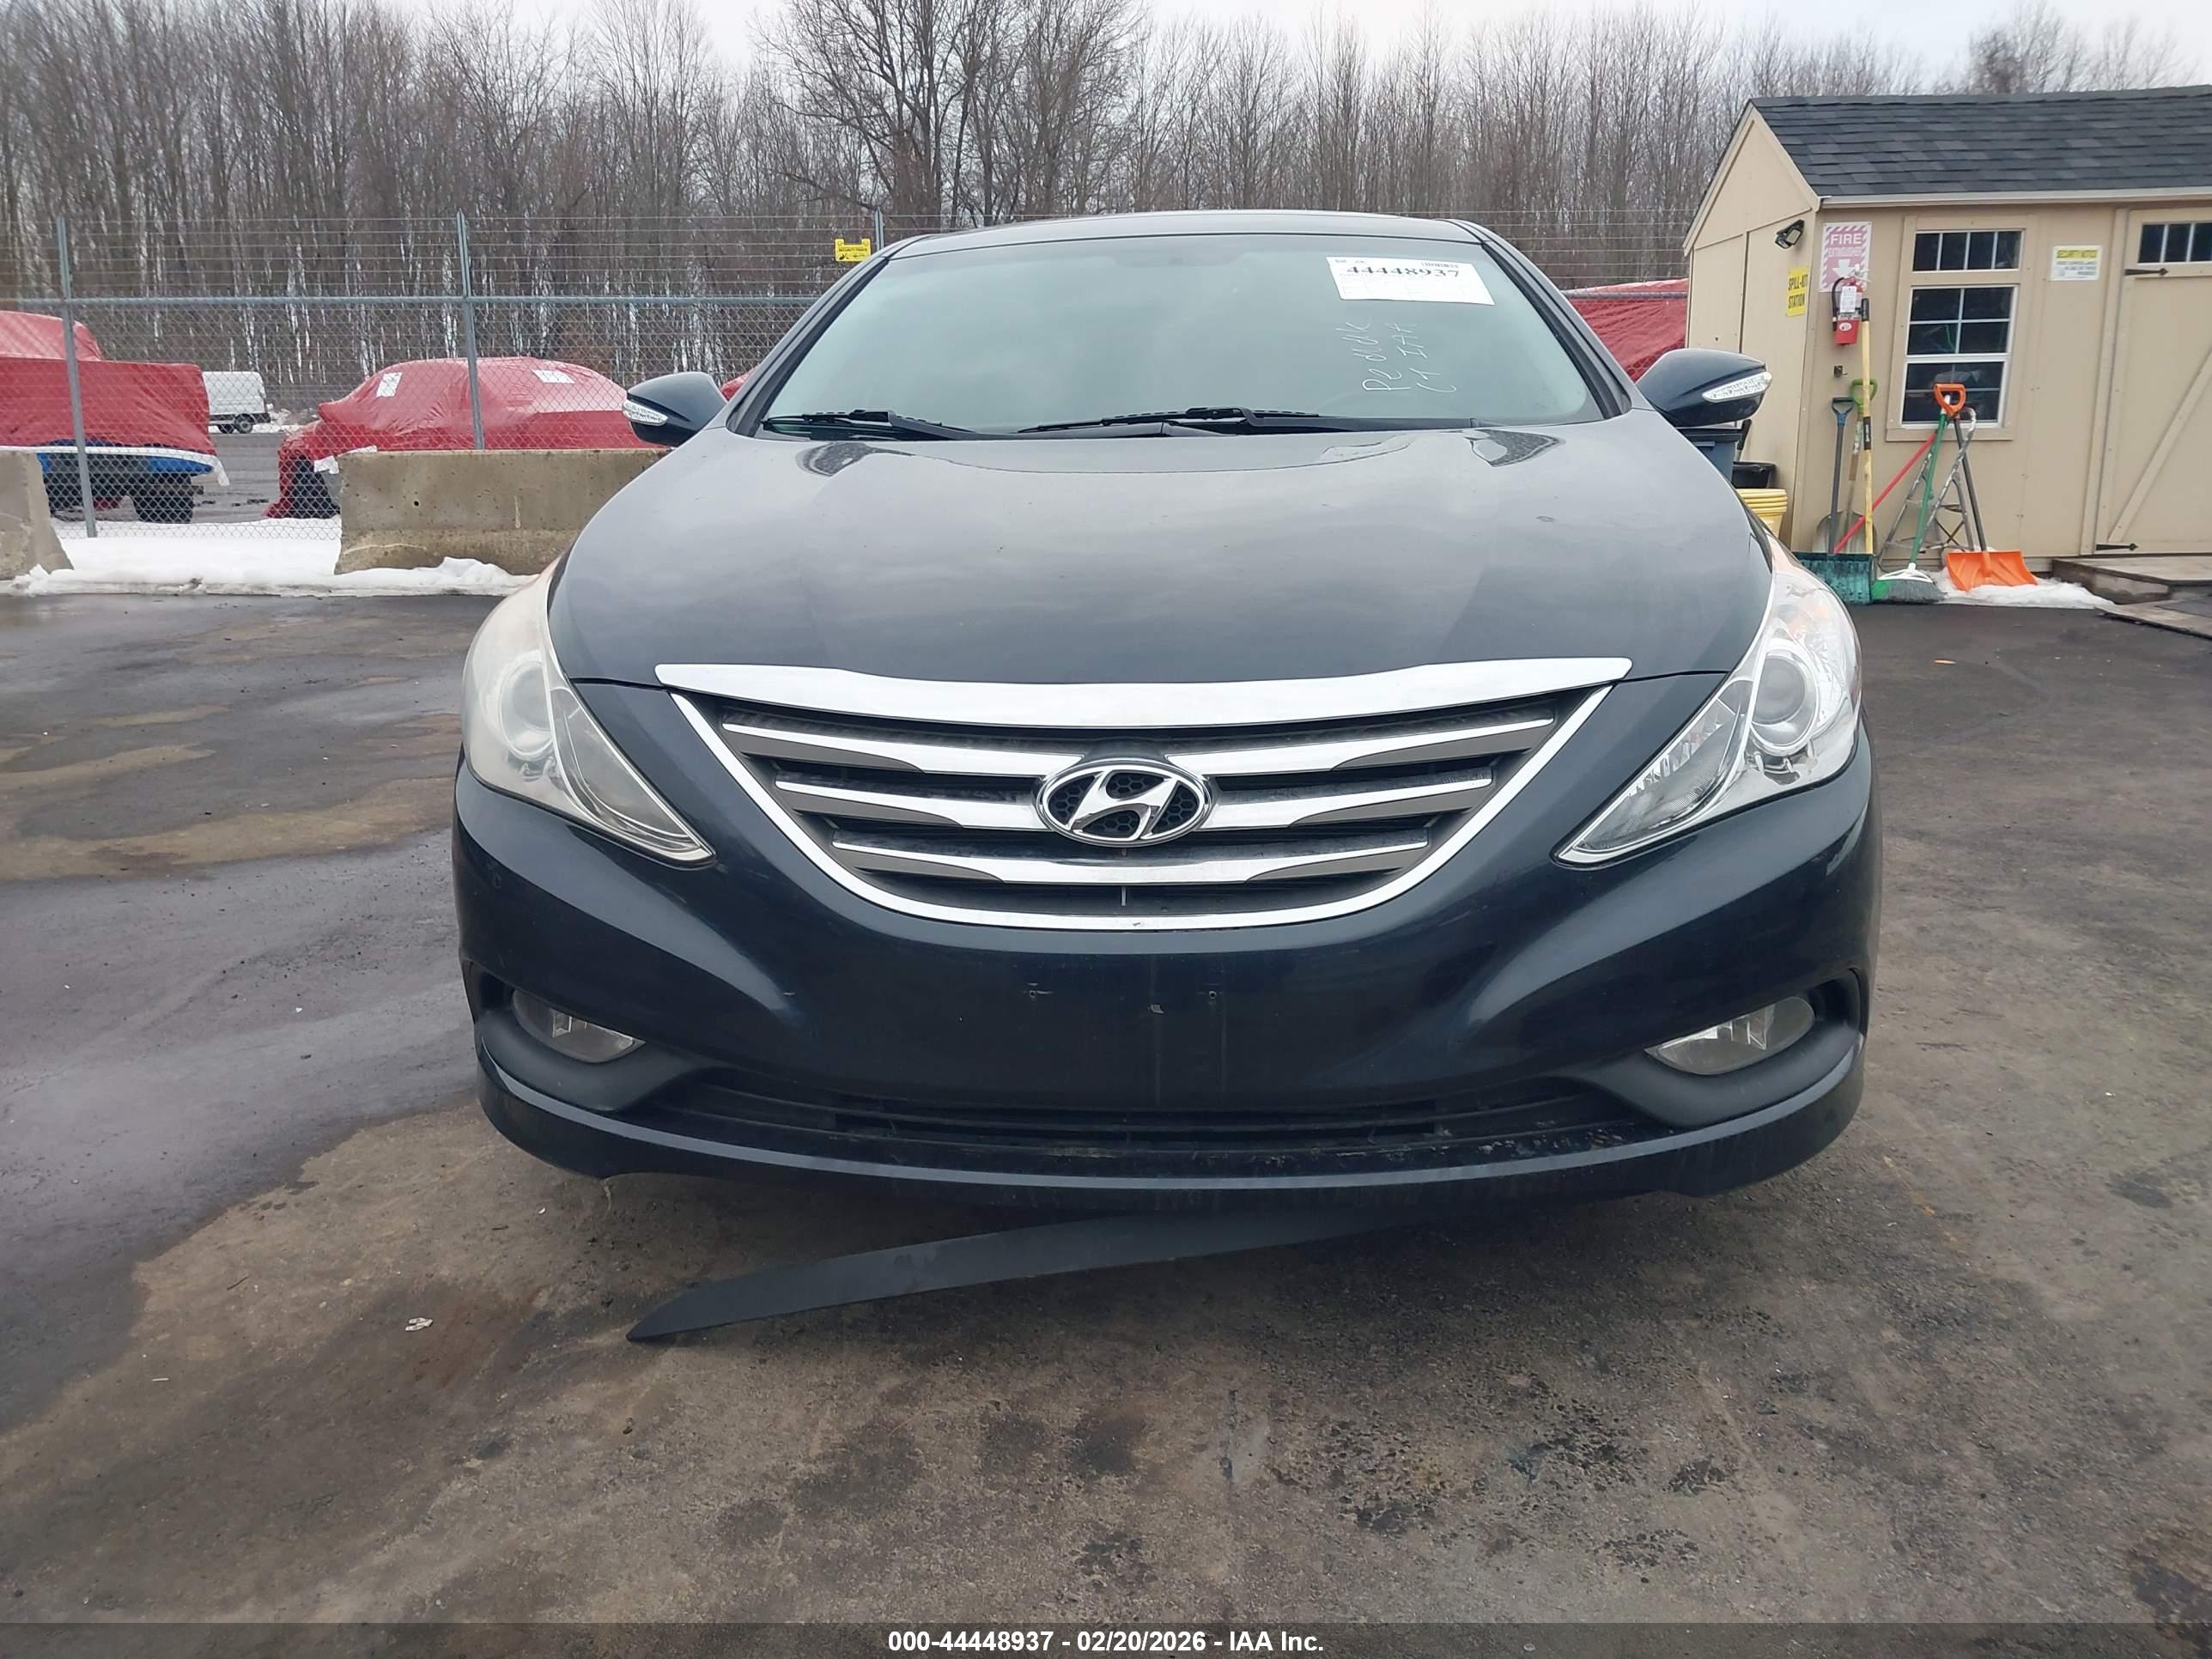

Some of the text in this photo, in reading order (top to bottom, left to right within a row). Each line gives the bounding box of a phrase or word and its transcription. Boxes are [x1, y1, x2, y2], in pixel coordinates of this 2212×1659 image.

[1830, 234, 1863, 245] FIRE
[1346, 265, 1460, 277] 44448937
[1788, 274, 1808, 291] SPILL-KIT
[1788, 293, 1806, 308] STATION
